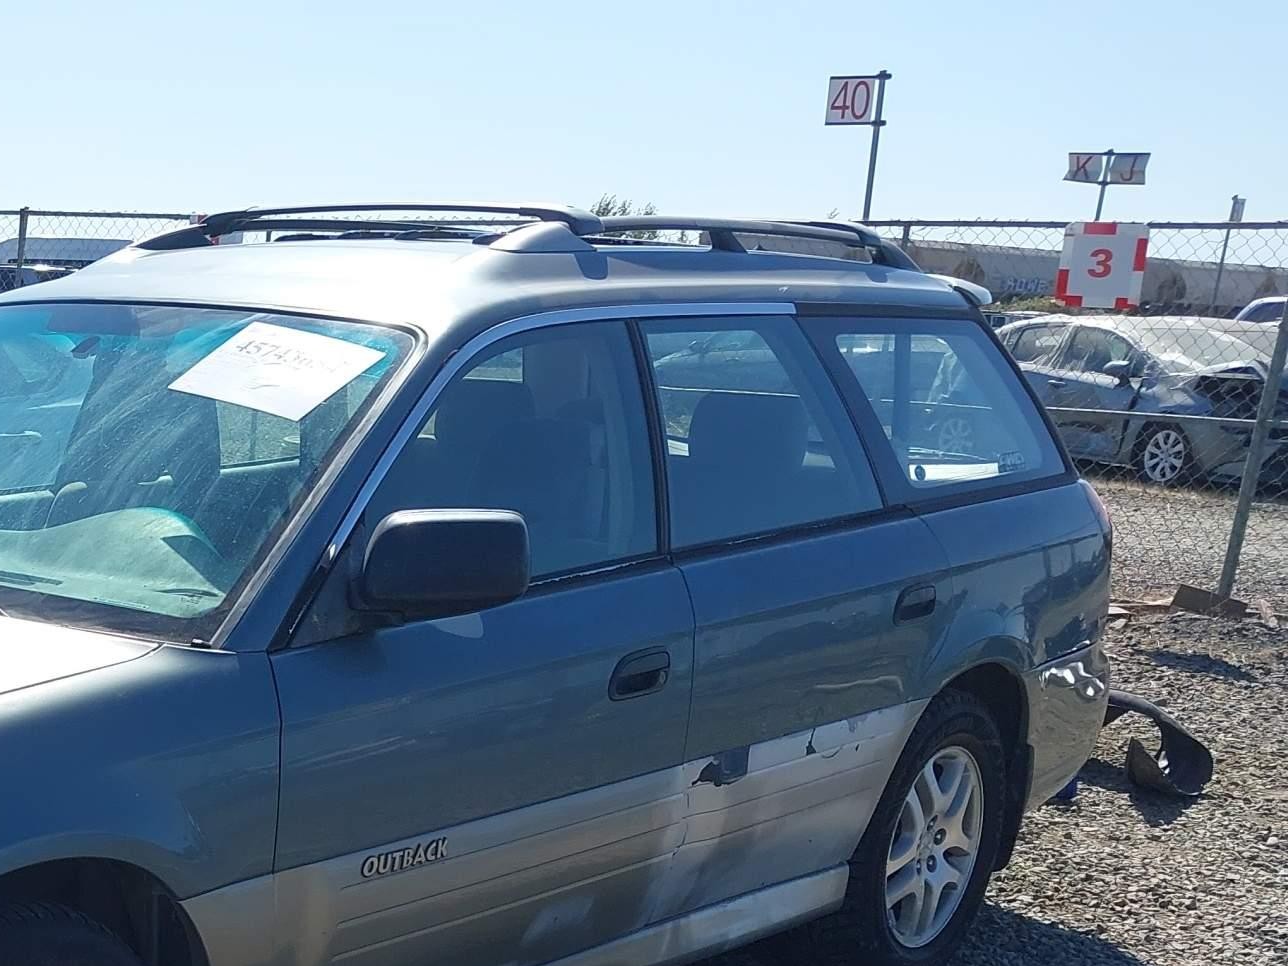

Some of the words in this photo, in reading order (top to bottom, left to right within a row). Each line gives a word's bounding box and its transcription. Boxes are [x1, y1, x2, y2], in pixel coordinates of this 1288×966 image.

[829, 79, 872, 121] 40
[1072, 155, 1094, 180] K
[1119, 155, 1138, 181] J
[1087, 248, 1114, 279] 3
[360, 836, 449, 879] OUTBACK
